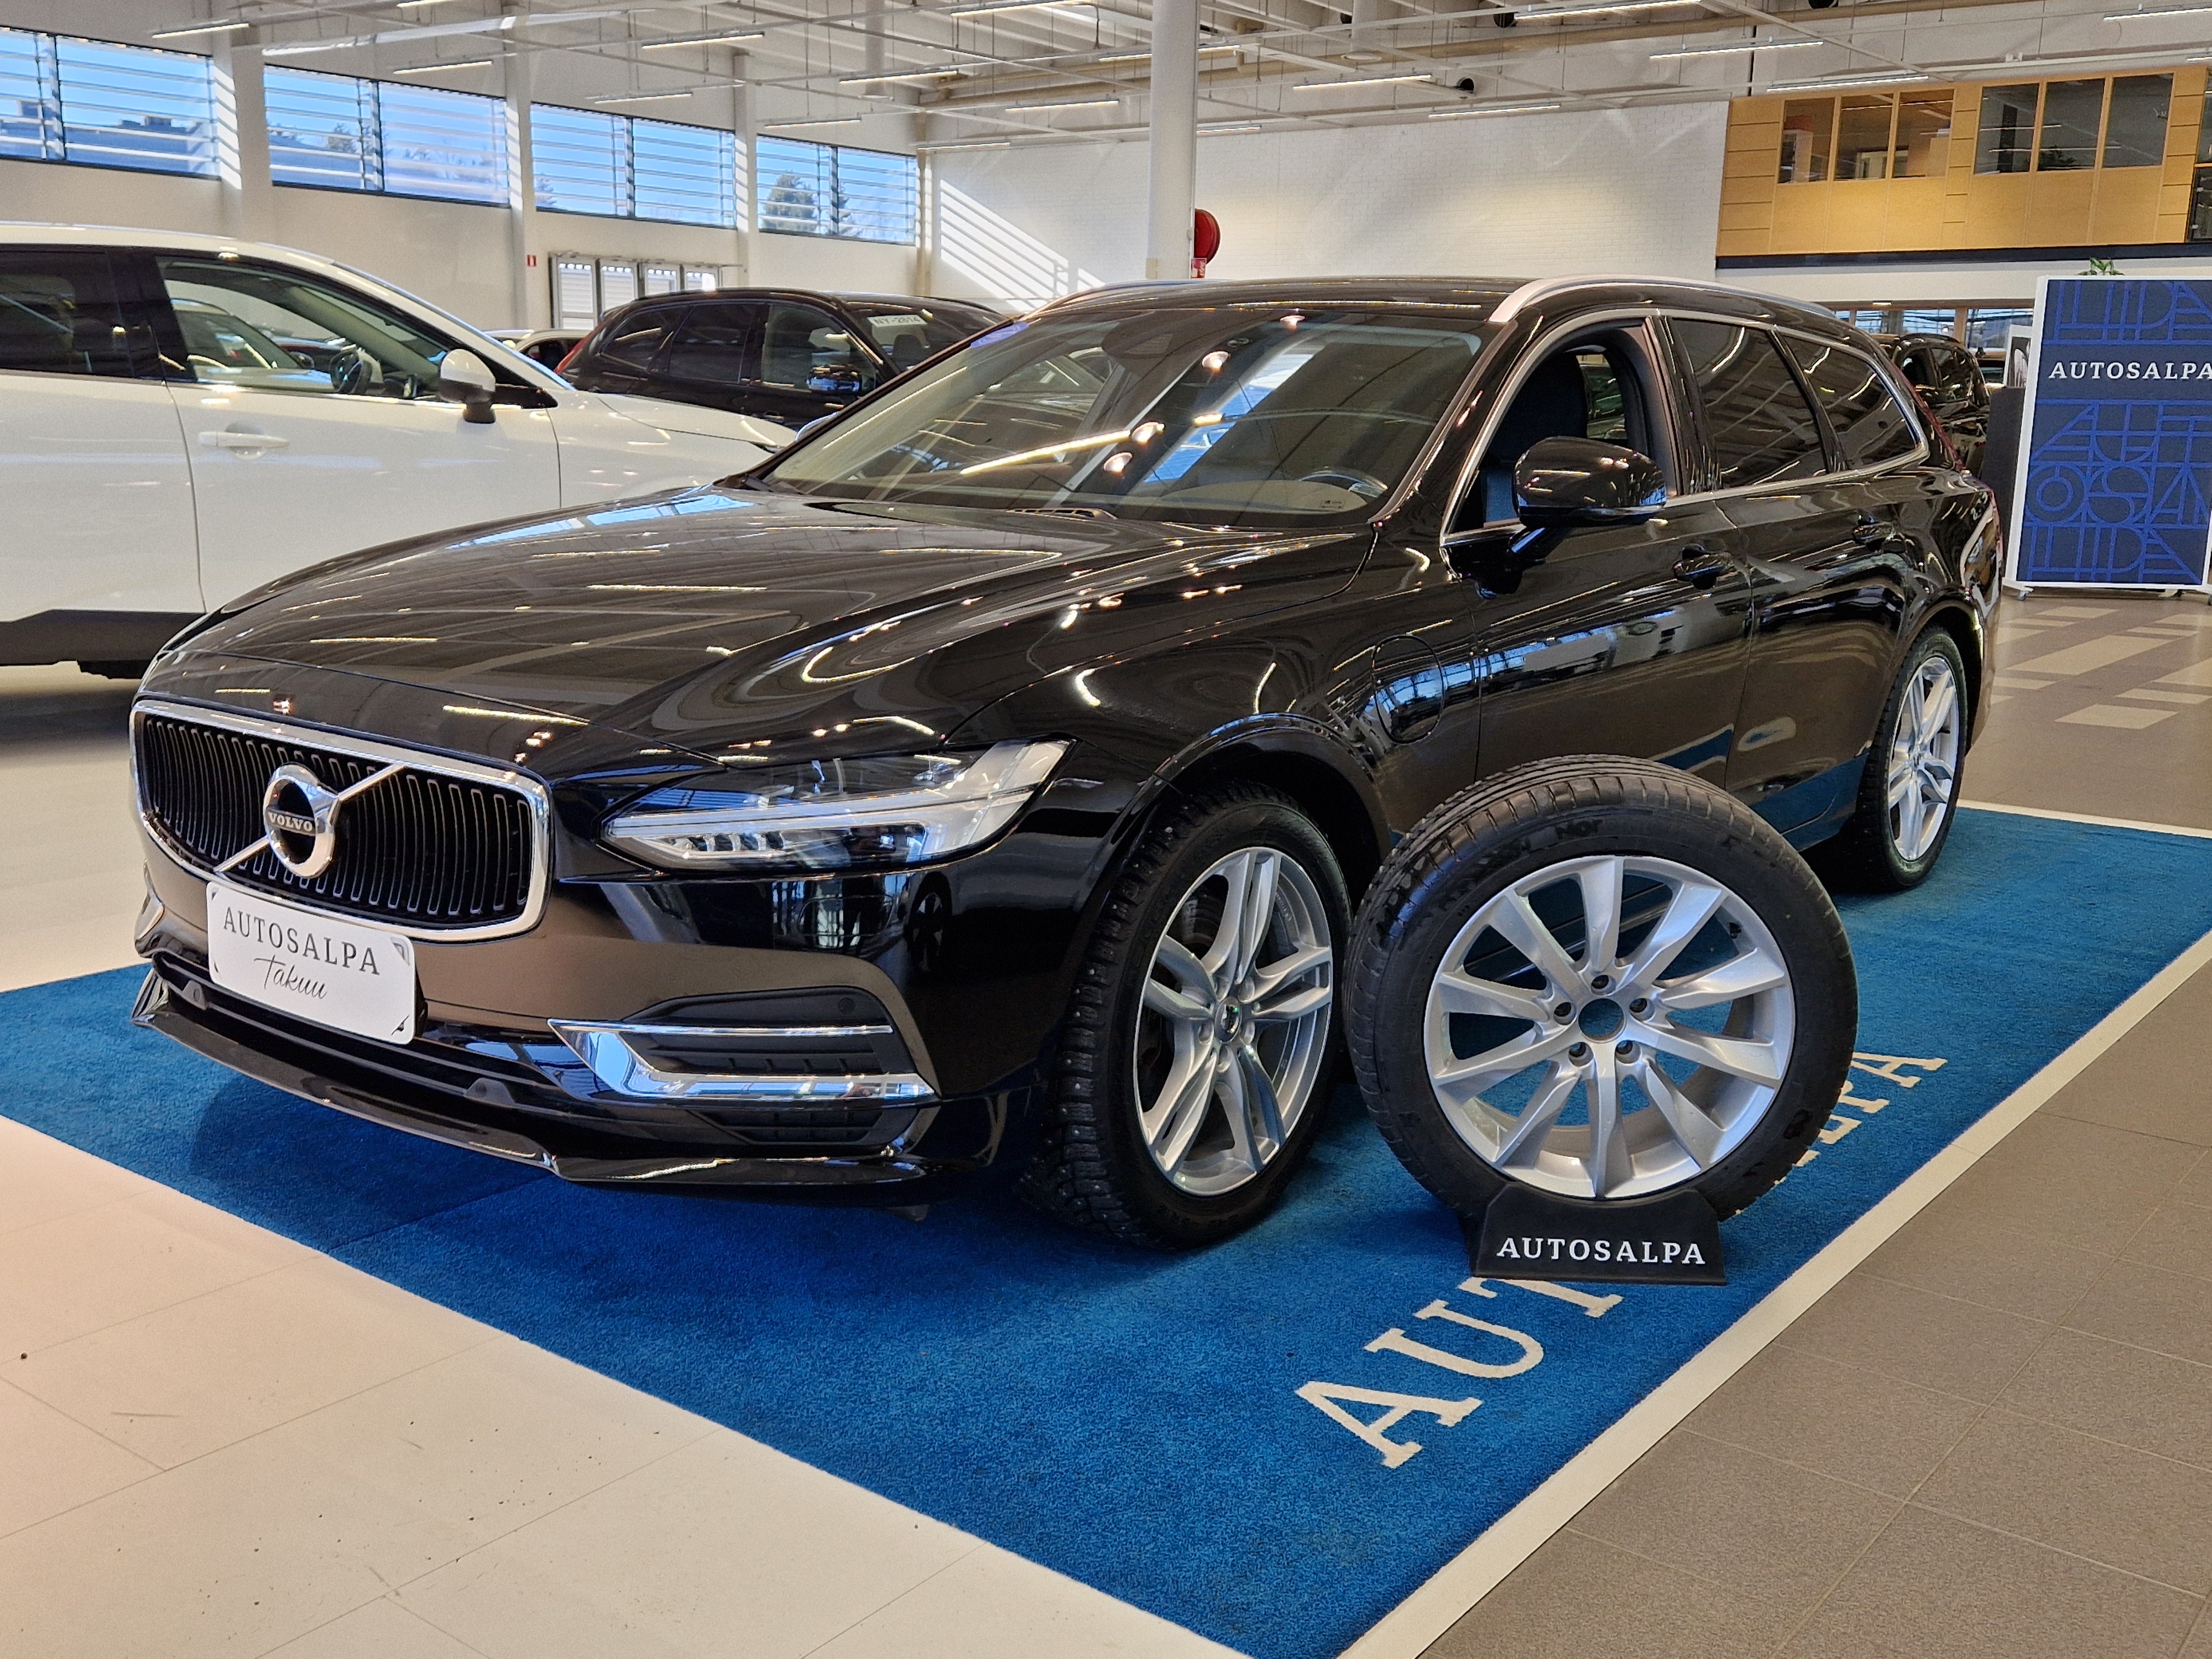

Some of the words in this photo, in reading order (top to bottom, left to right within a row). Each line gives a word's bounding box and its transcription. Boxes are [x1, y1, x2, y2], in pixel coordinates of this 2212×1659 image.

[2048, 362, 2212, 380] AUTOSALPA
[267, 812, 313, 832] VOLVO
[223, 906, 380, 975] AUTOSALPA
[254, 954, 328, 999] Takuu
[1496, 1237, 1705, 1264] AUTOSALPA
